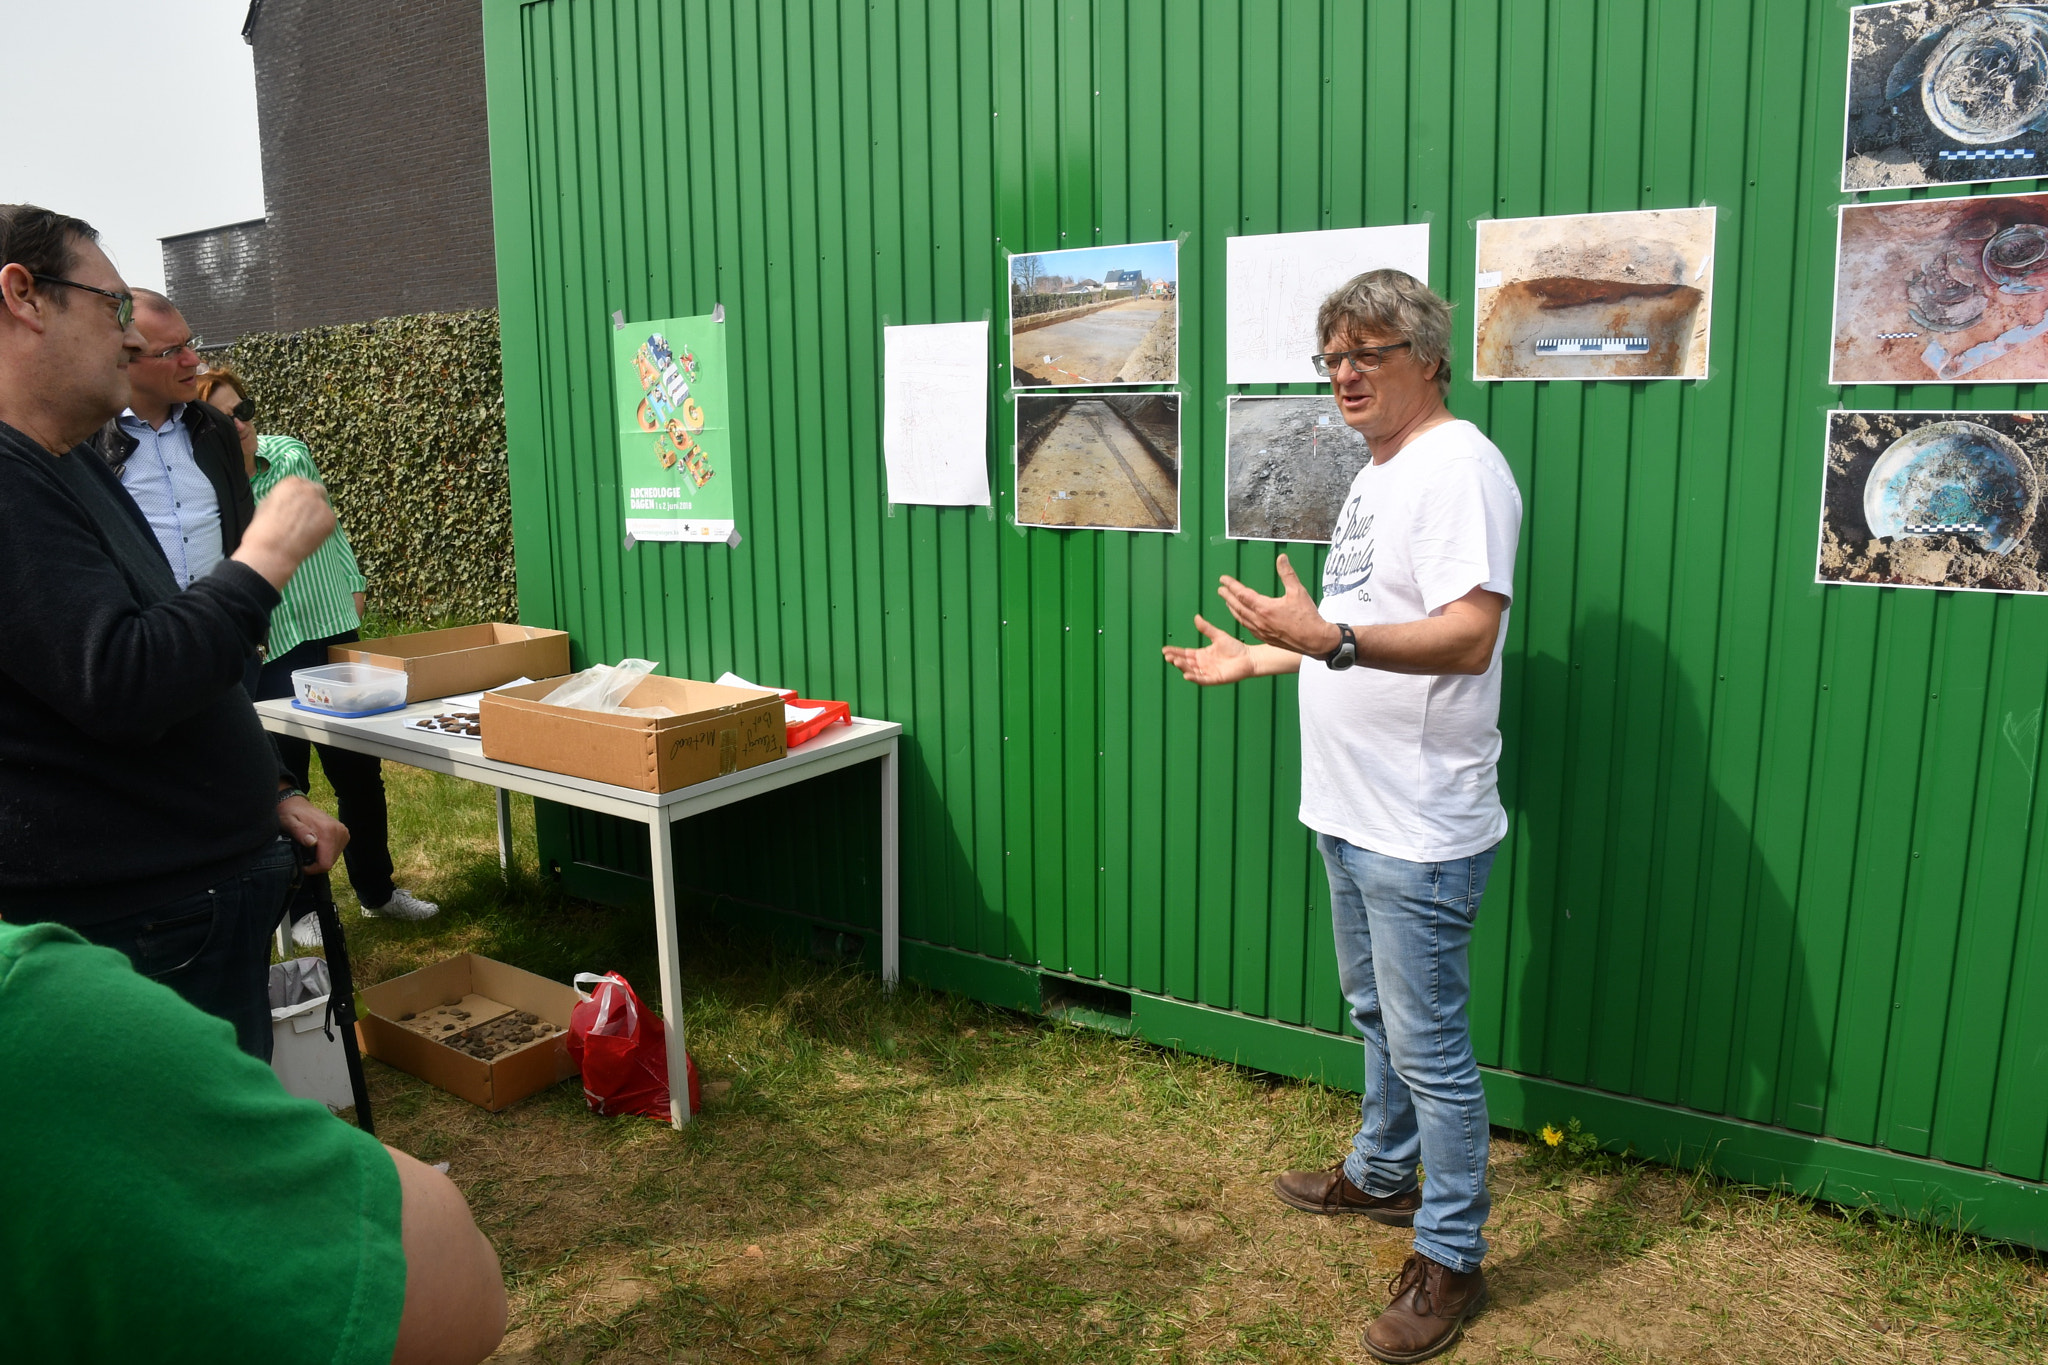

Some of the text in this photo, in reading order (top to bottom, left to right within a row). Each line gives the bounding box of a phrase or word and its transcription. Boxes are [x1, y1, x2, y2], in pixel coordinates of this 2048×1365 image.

[630, 487, 681, 498] ARCHEOLOGIE
[630, 499, 655, 510] DAGEN
[662, 502, 667, 510] 2
[667, 502, 679, 512] juni
[1335, 495, 1374, 549] True
[1358, 589, 1372, 602] Co.
